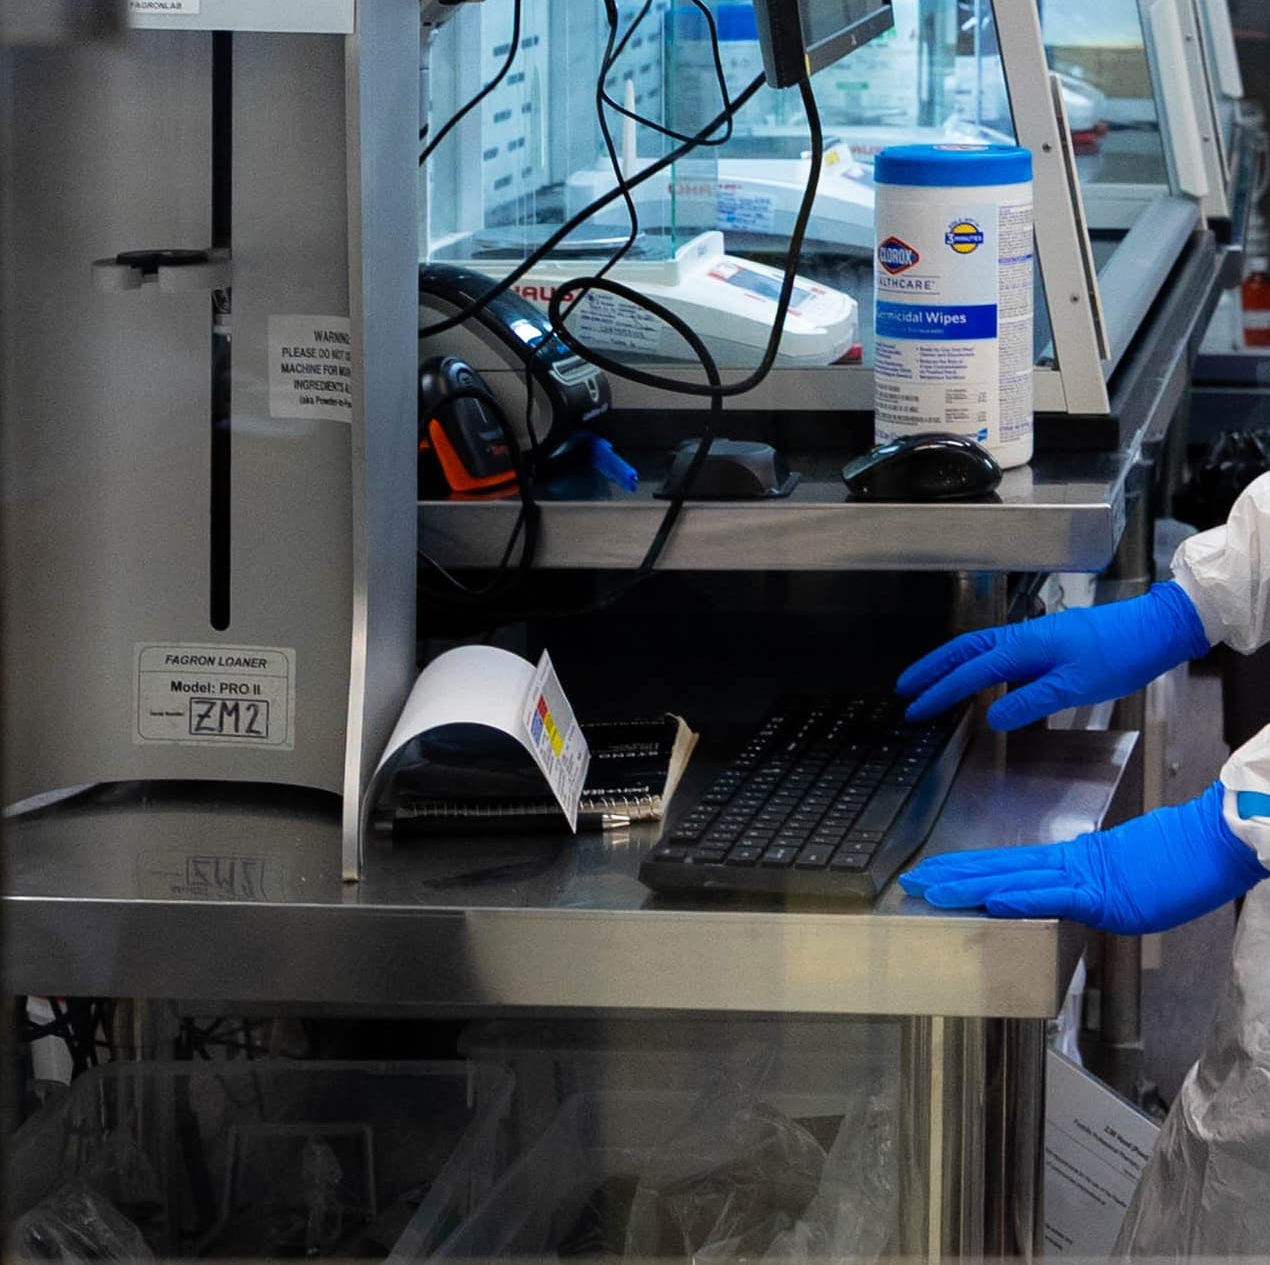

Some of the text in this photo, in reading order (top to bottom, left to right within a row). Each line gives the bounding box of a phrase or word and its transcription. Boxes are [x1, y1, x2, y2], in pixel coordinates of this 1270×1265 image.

[880, 247, 912, 265] CLOROX
[926, 312, 967, 326] Wipes
[281, 347, 317, 358] PLEASE
[319, 348, 330, 359] DO
[332, 350, 344, 360] NOT
[281, 363, 322, 375] MACHINE
[323, 365, 338, 376] FOR
[165, 655, 268, 669] FAGRON LOANER
[170, 681, 261, 695] Model: PRO II
[193, 700, 263, 734] ZM2
